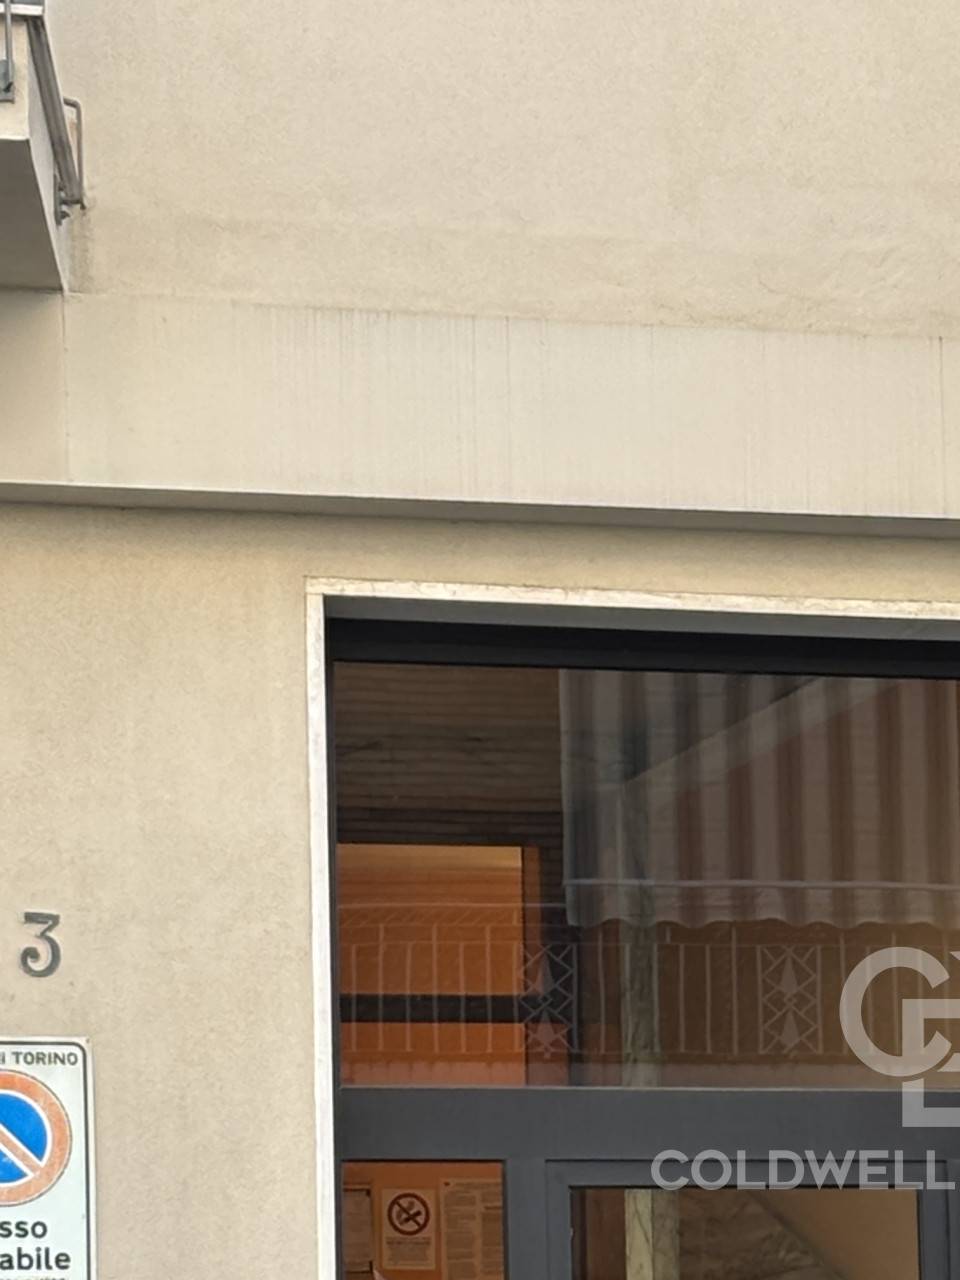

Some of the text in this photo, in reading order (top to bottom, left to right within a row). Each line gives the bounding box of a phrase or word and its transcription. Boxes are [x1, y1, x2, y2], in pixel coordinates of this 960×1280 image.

[20, 912, 61, 977] 3
[11, 1051, 78, 1066] TORINO
[0, 1220, 48, 1239] sso
[0, 1246, 71, 1271] abile
